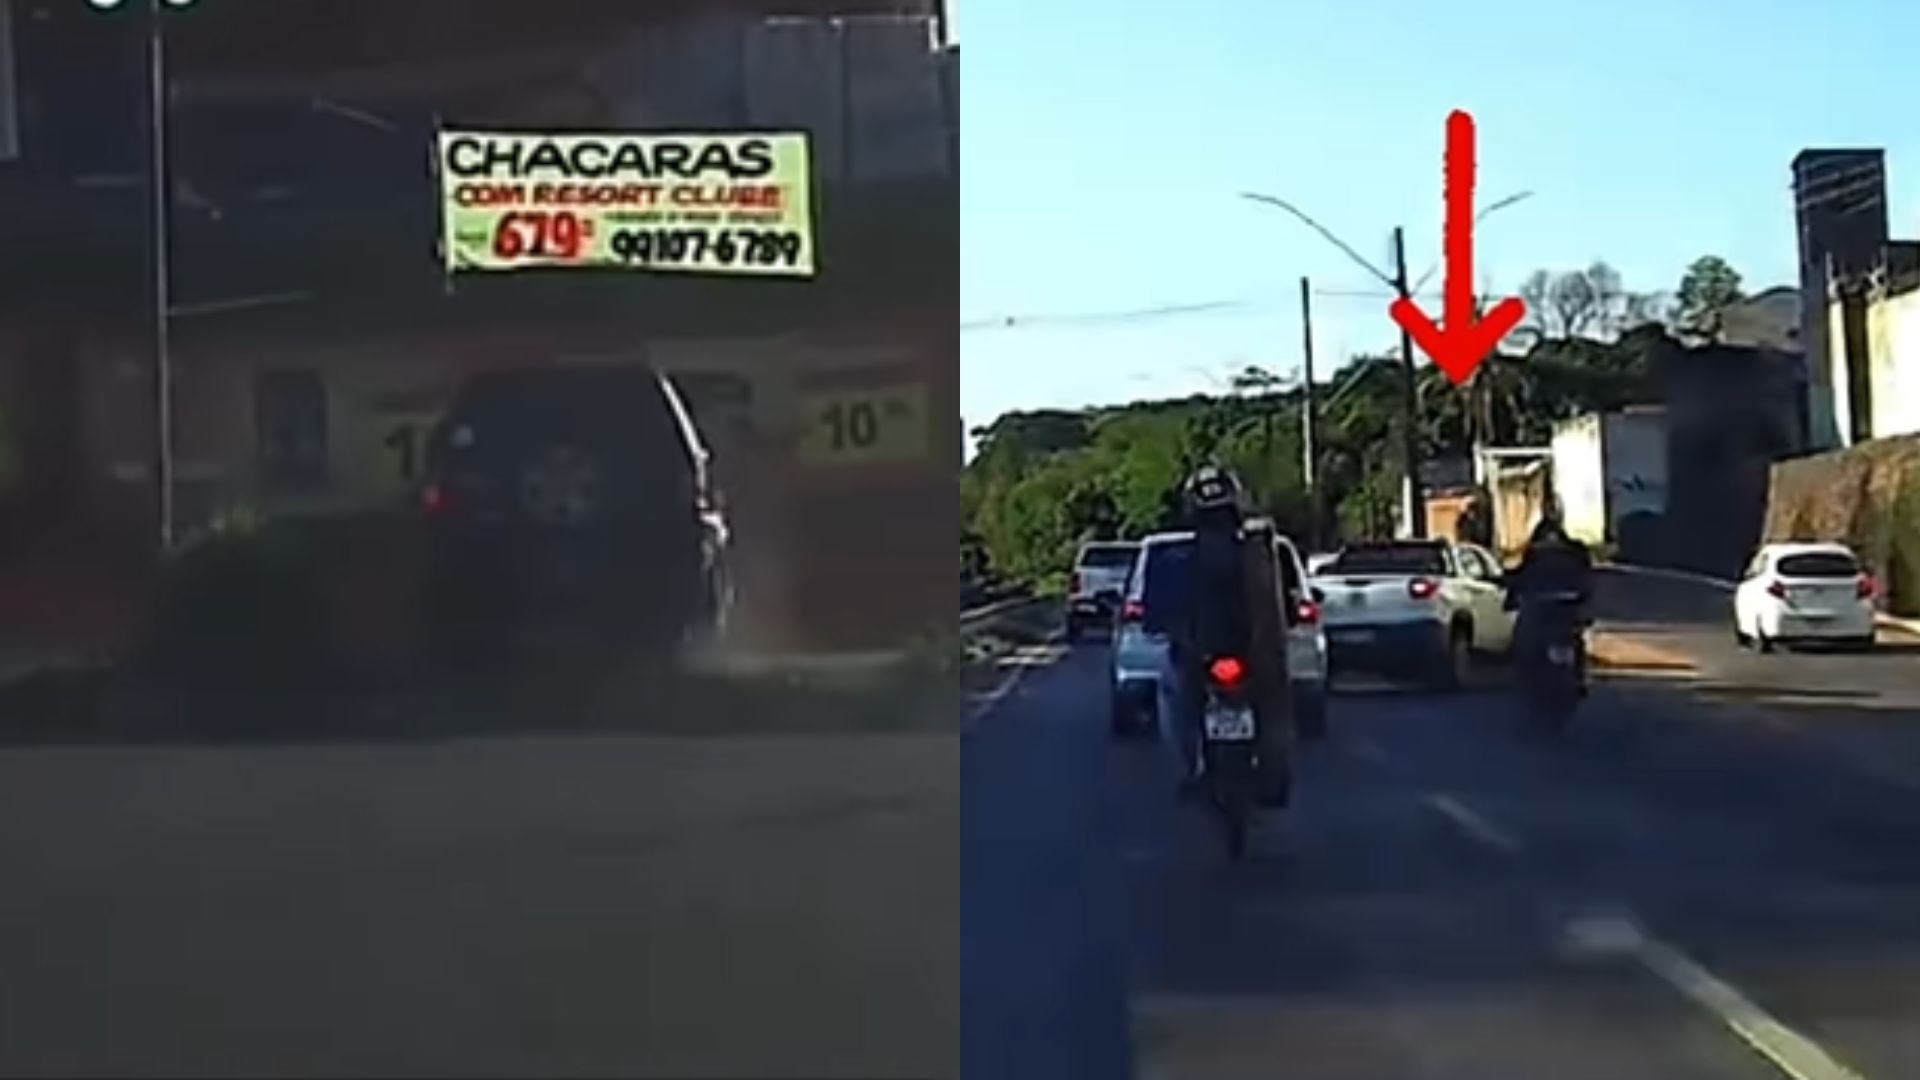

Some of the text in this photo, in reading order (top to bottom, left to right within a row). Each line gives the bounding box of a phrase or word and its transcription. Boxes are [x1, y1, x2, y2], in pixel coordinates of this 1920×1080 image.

[455, 184, 782, 208] COM RESORT CLUBE
[819, 403, 879, 449] 10
